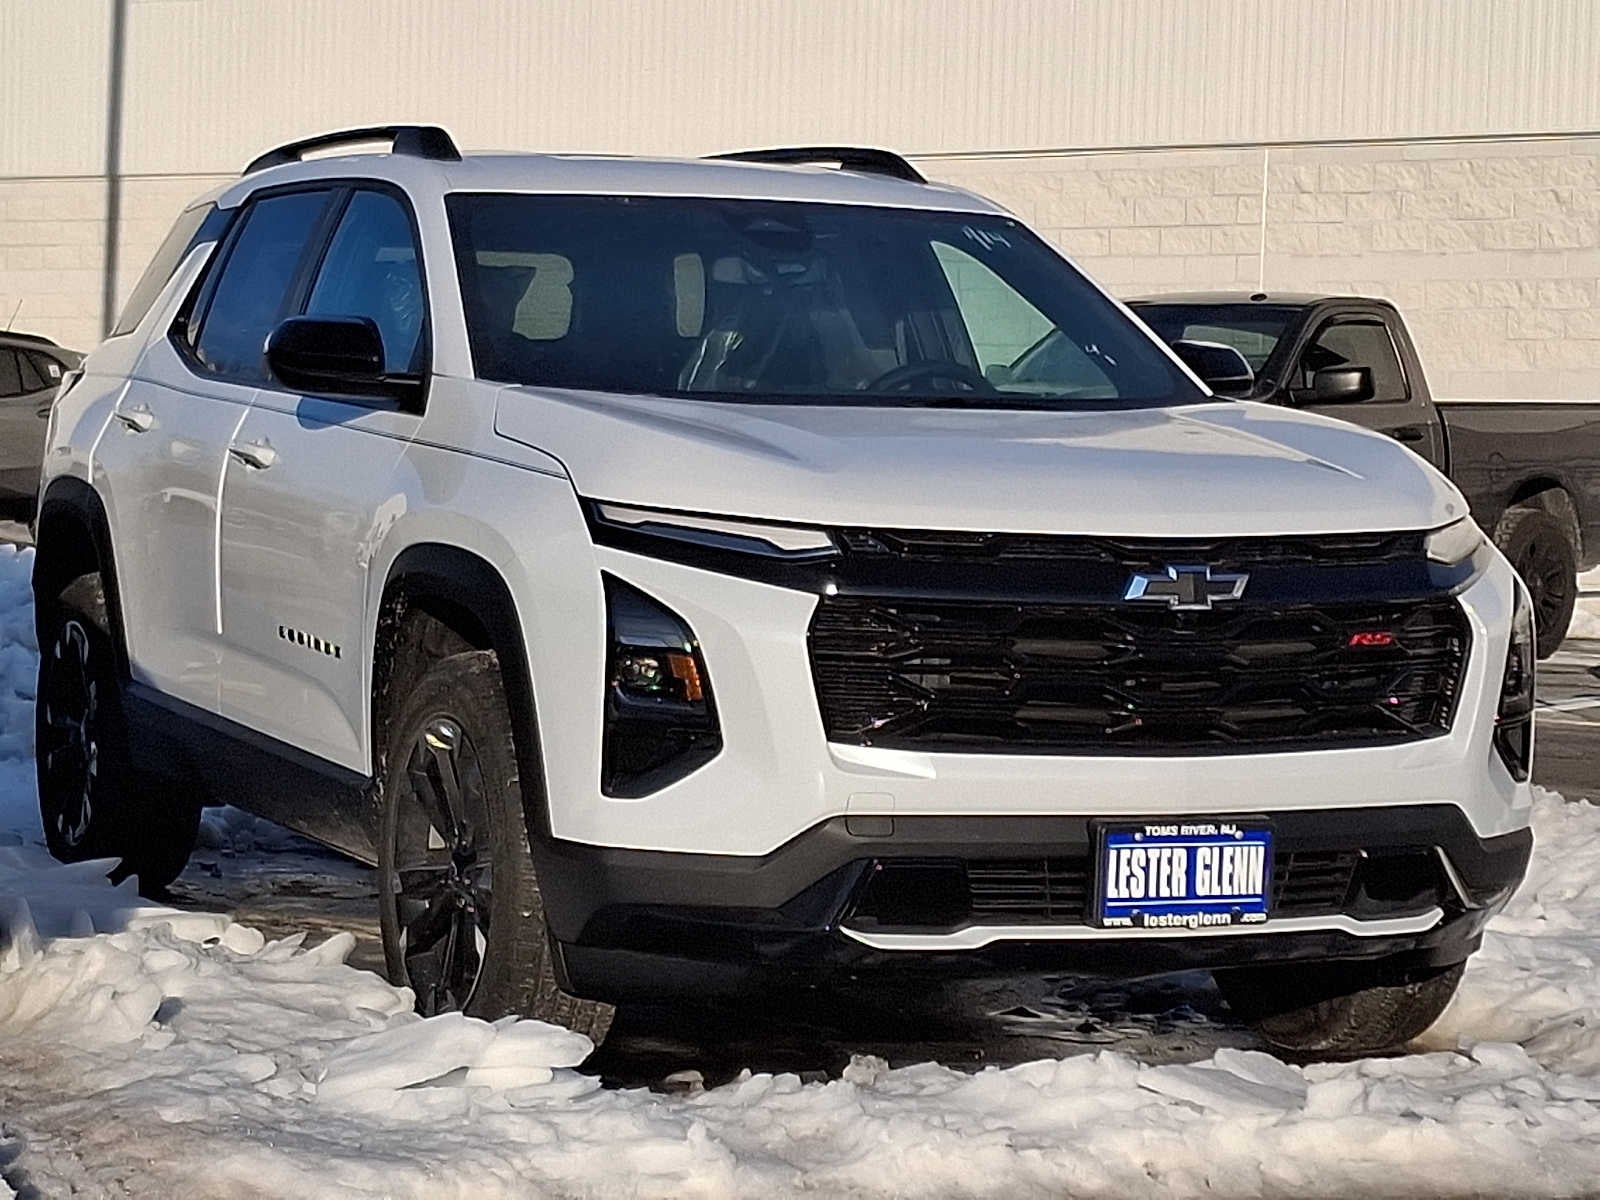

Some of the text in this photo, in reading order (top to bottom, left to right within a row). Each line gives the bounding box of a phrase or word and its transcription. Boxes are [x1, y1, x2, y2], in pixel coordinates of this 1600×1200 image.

[1349, 631, 1393, 646] RS
[1144, 825, 1178, 836] TOMS
[1106, 846, 1265, 899] LESTER GLENN
[1143, 912, 1232, 929] lesterglenn
